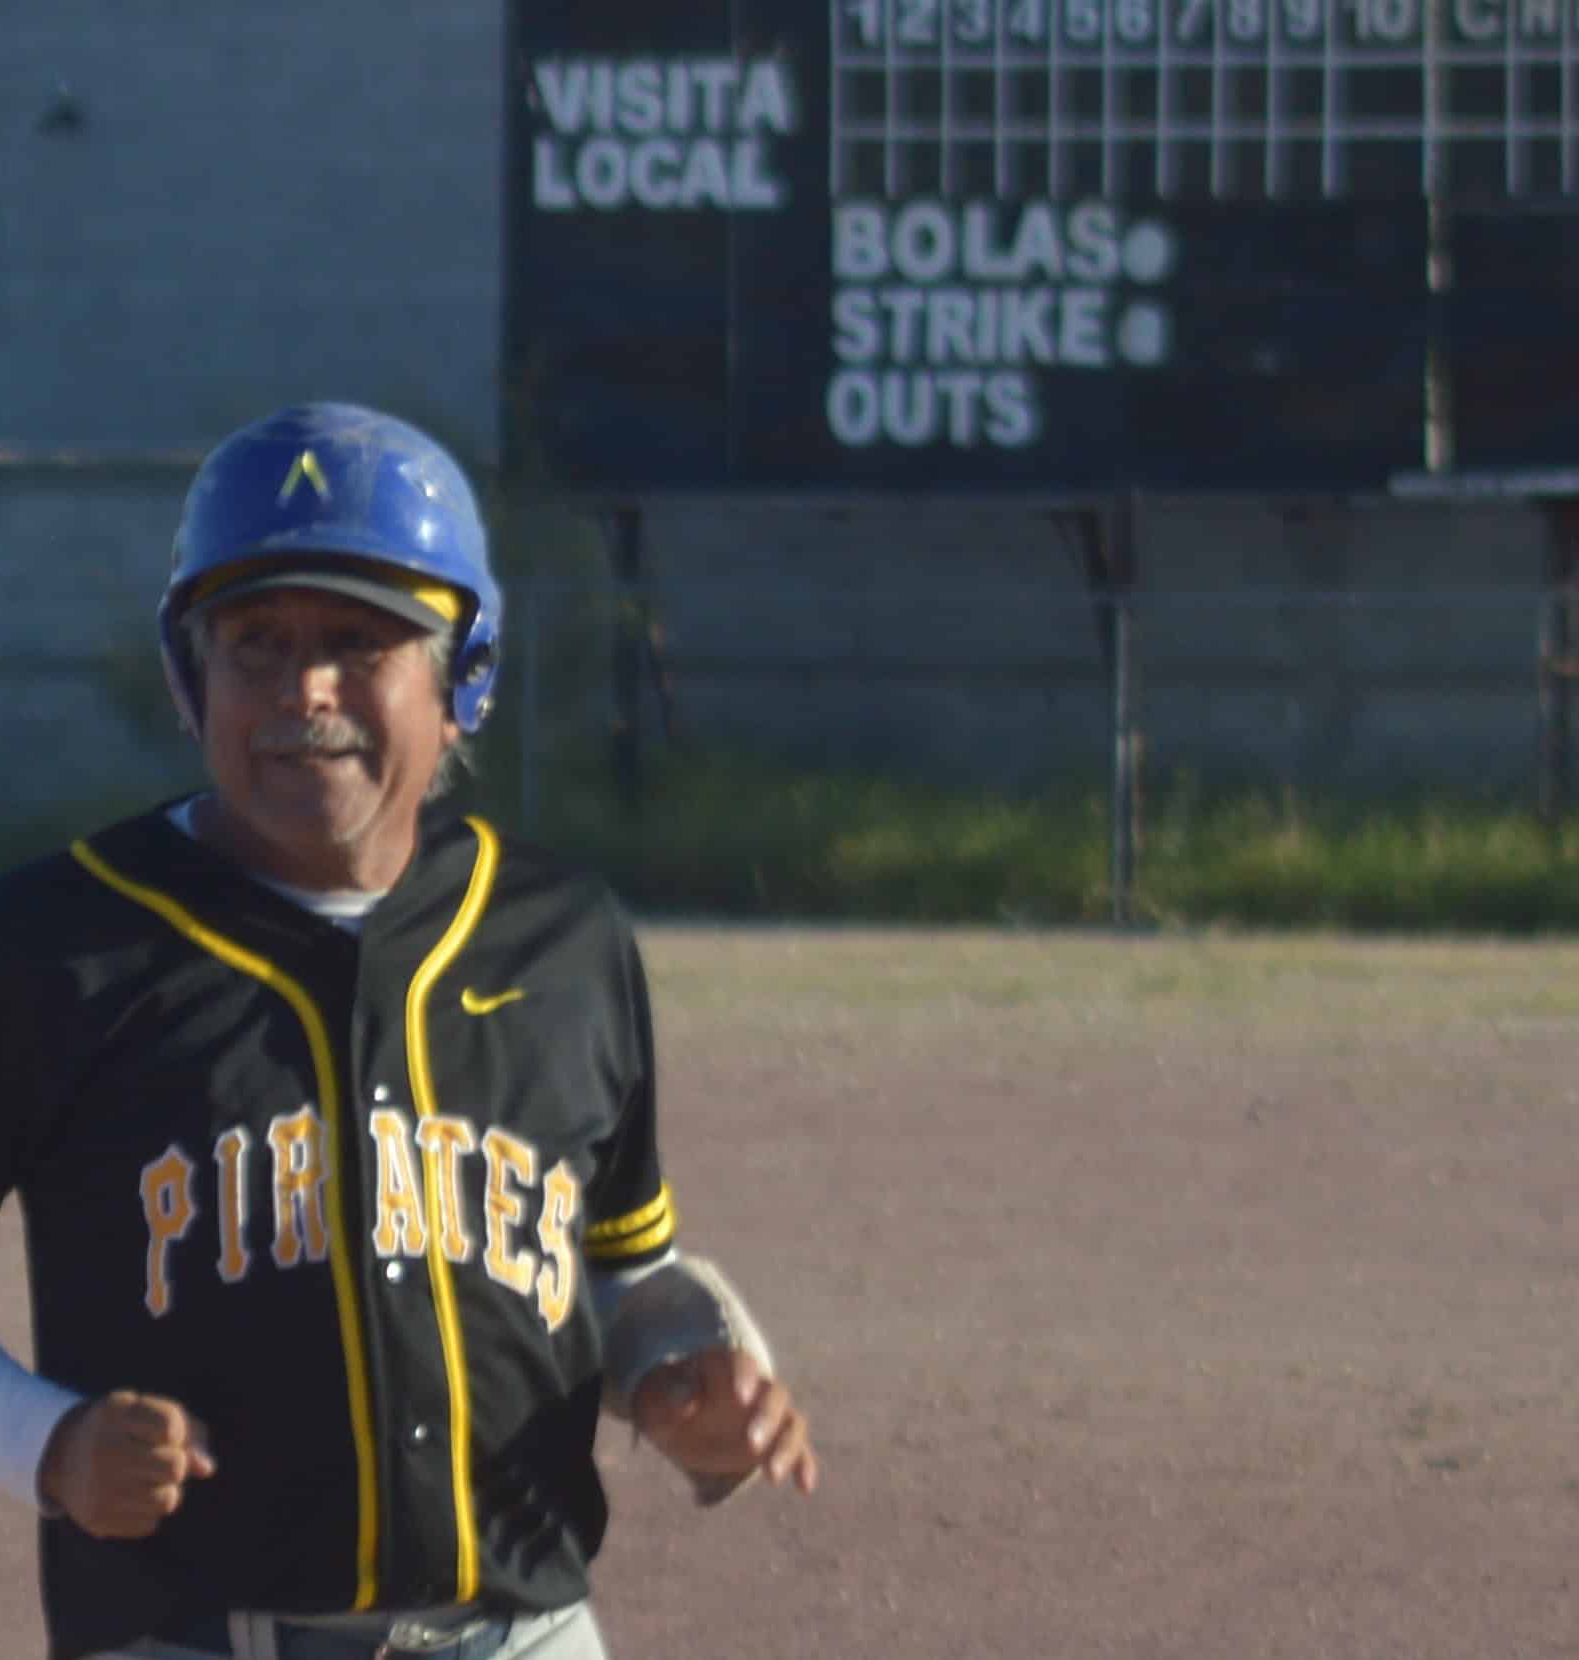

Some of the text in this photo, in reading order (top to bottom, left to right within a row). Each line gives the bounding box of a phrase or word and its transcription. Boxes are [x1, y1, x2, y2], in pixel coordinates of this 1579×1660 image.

[846, 0, 879, 42] 1
[897, 0, 936, 41] 2
[534, 60, 791, 134] VISITA
[534, 138, 781, 208] LOCAL
[832, 203, 1119, 281] BOLAS
[832, 288, 1108, 364] STRIKE
[828, 371, 1035, 447] OUTS
[139, 1102, 580, 1336] PIRATES
